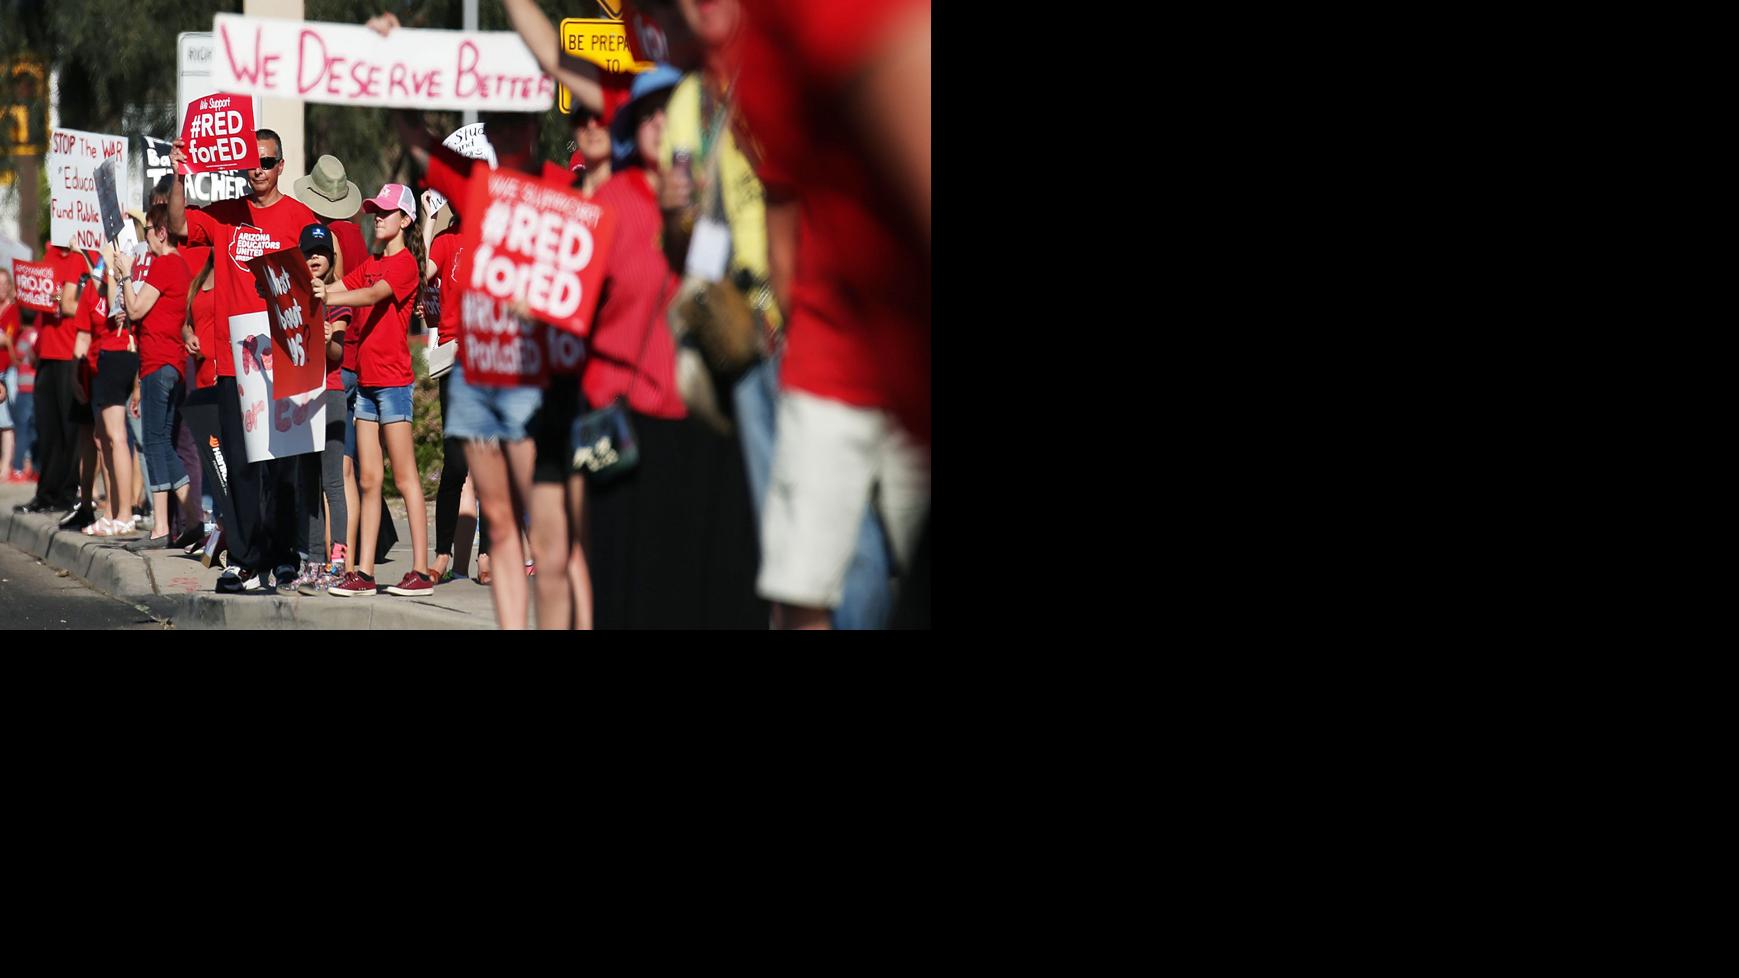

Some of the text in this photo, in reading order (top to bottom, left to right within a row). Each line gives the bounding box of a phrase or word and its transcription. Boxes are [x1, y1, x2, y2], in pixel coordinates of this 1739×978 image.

[569, 35, 584, 50] BE
[297, 29, 442, 98] DESERVE
[606, 59, 620, 73] TO
[209, 97, 230, 111] Support
[190, 110, 243, 138] #RED
[53, 132, 75, 155] STOP
[80, 138, 97, 159] The
[101, 139, 122, 161] WAR
[188, 137, 247, 163] forED
[51, 198, 73, 220] Fund
[76, 200, 99, 223] Public
[237, 240, 281, 250] EDUCATORS
[238, 232, 270, 242] ARIZONA
[482, 200, 594, 273] #RED
[236, 247, 263, 257] UNITED
[471, 243, 583, 320] forED
